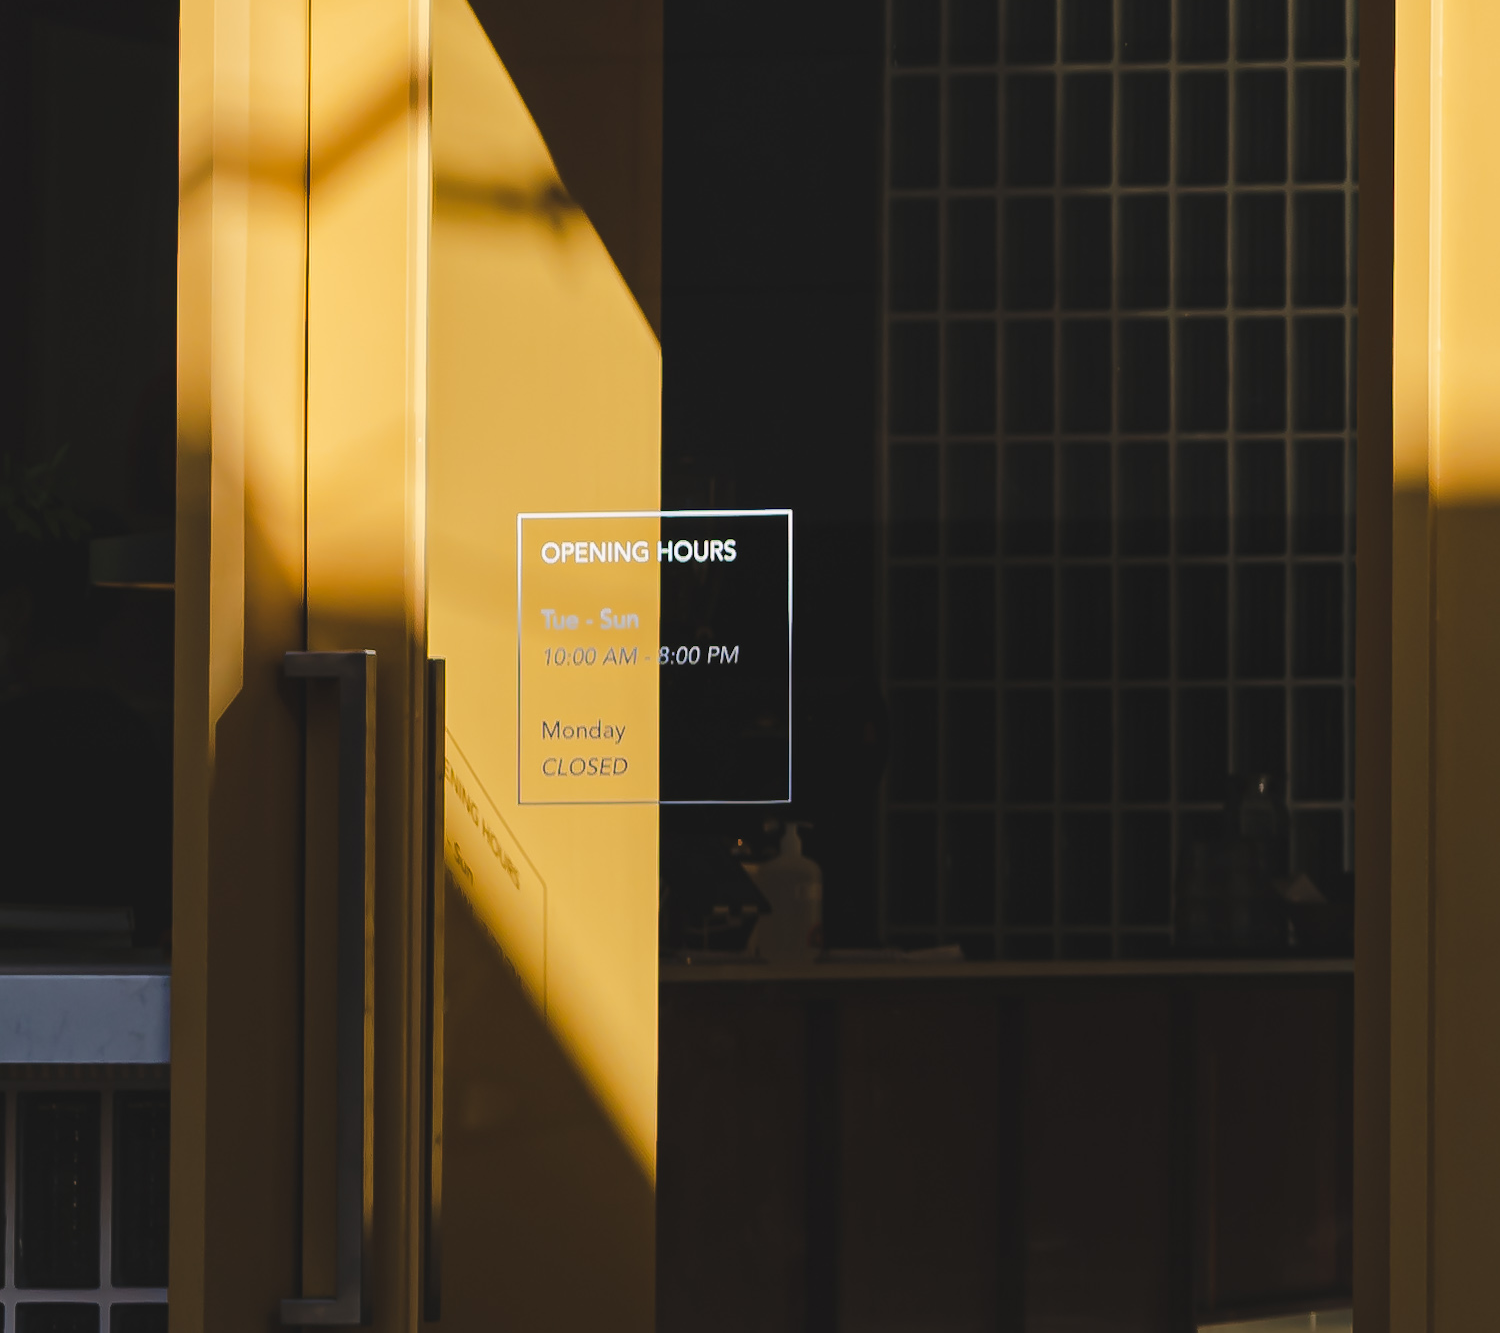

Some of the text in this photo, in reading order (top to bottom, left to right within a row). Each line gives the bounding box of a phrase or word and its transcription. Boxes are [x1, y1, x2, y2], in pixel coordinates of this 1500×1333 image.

[540, 539, 737, 564] OPENING HOURS
[541, 608, 578, 631] Tue
[600, 608, 639, 630] Sun
[543, 647, 596, 666] 10:00
[602, 646, 638, 666] AM
[657, 645, 701, 665] 8:00
[707, 645, 740, 664] PM
[541, 719, 626, 745] Monday
[541, 757, 628, 777] CLOSED
